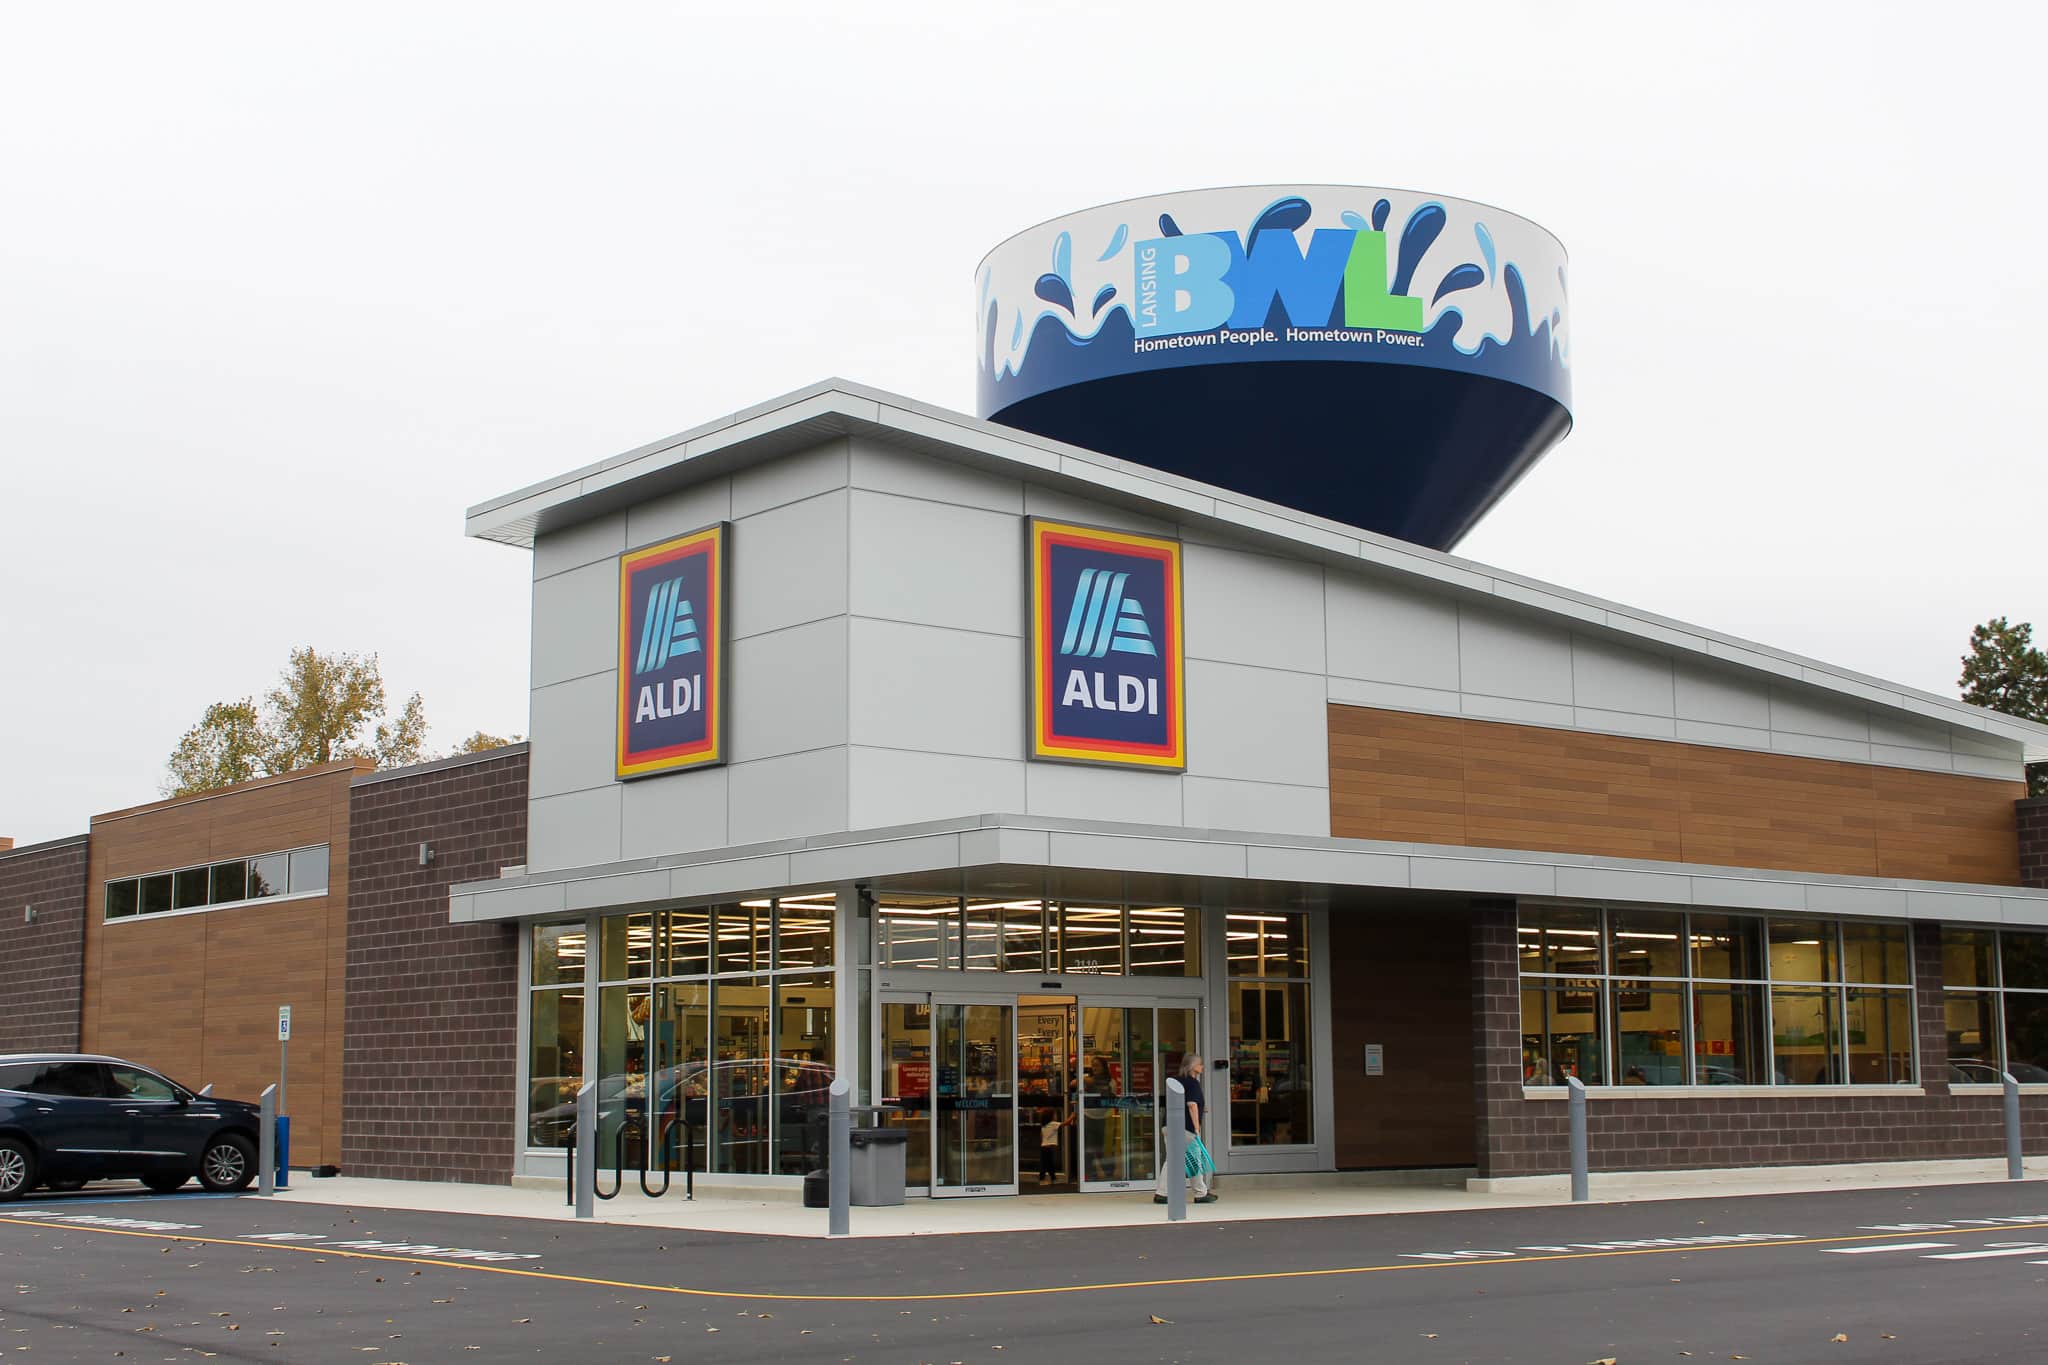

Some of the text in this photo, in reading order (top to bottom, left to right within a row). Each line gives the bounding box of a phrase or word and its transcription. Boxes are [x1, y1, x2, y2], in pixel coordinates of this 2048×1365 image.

[1135, 229, 1424, 338] BWL
[1141, 247, 1157, 328] LANSING
[1134, 328, 1425, 353] Hometown People. Hometown Power.
[635, 674, 701, 723] ALDI
[1062, 669, 1158, 715] ALDI
